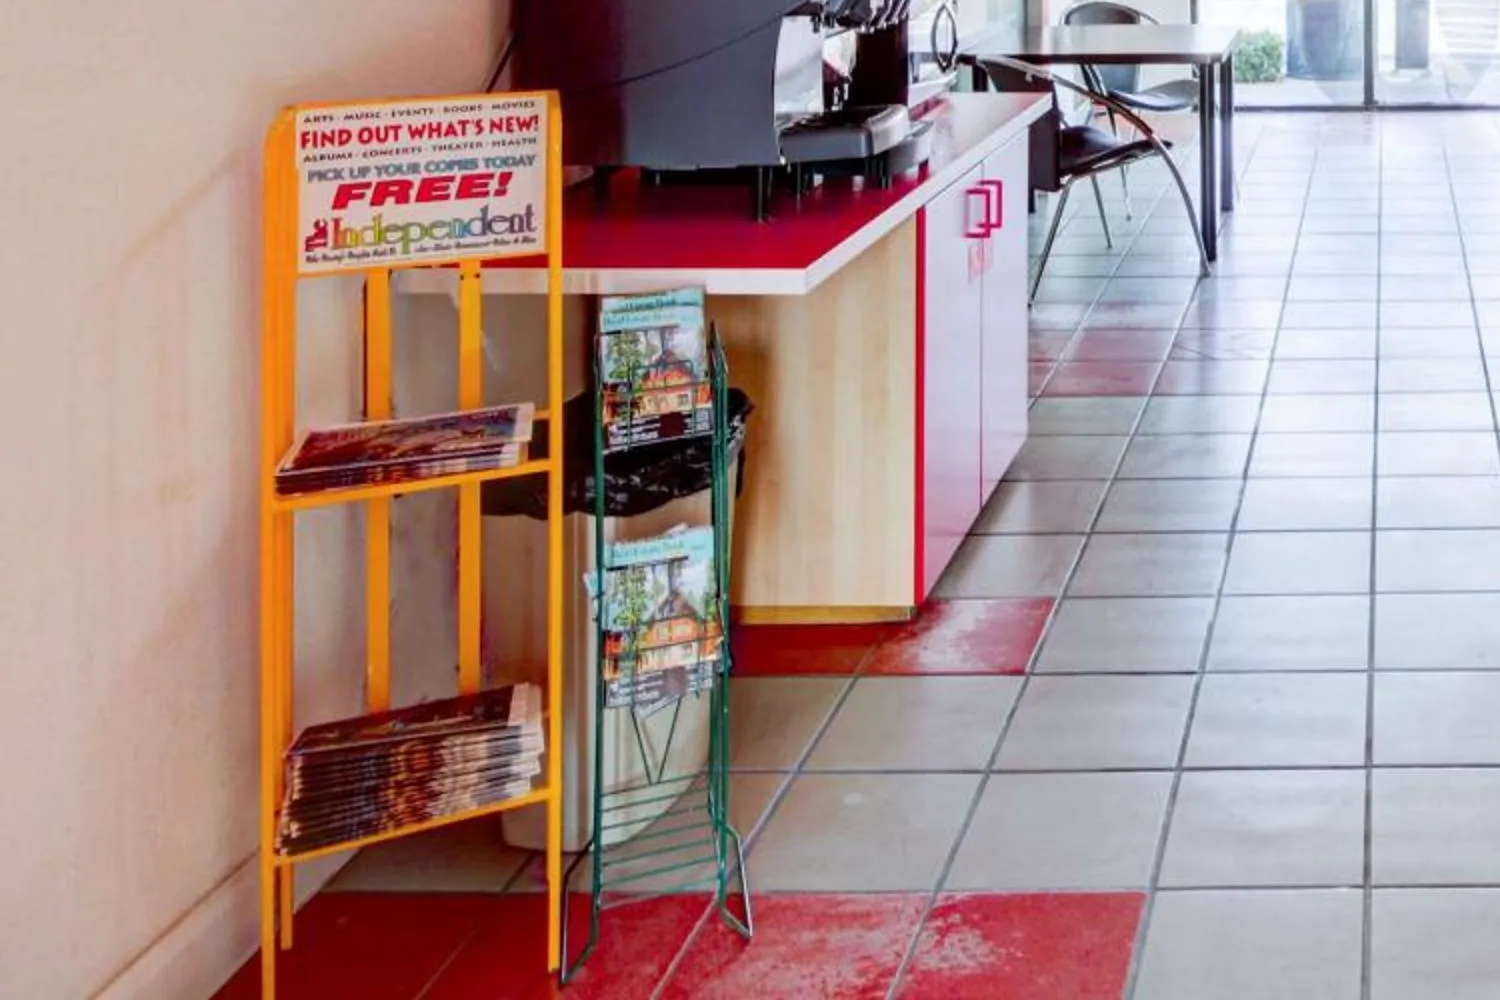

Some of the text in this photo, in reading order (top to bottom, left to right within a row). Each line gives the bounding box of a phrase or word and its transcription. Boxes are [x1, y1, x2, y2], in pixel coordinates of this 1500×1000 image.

[391, 107, 435, 118] EVENTS
[491, 100, 536, 111] MOVIES
[300, 114, 540, 150] FIND OUT WHAT'S NEW!
[491, 137, 537, 149] HEALTH
[307, 167, 345, 183] PICK
[349, 165, 372, 179] UP
[374, 162, 422, 178] YOUR
[483, 153, 537, 169] TODAY
[331, 171, 514, 211] FREE!
[332, 202, 538, 256] Independent
